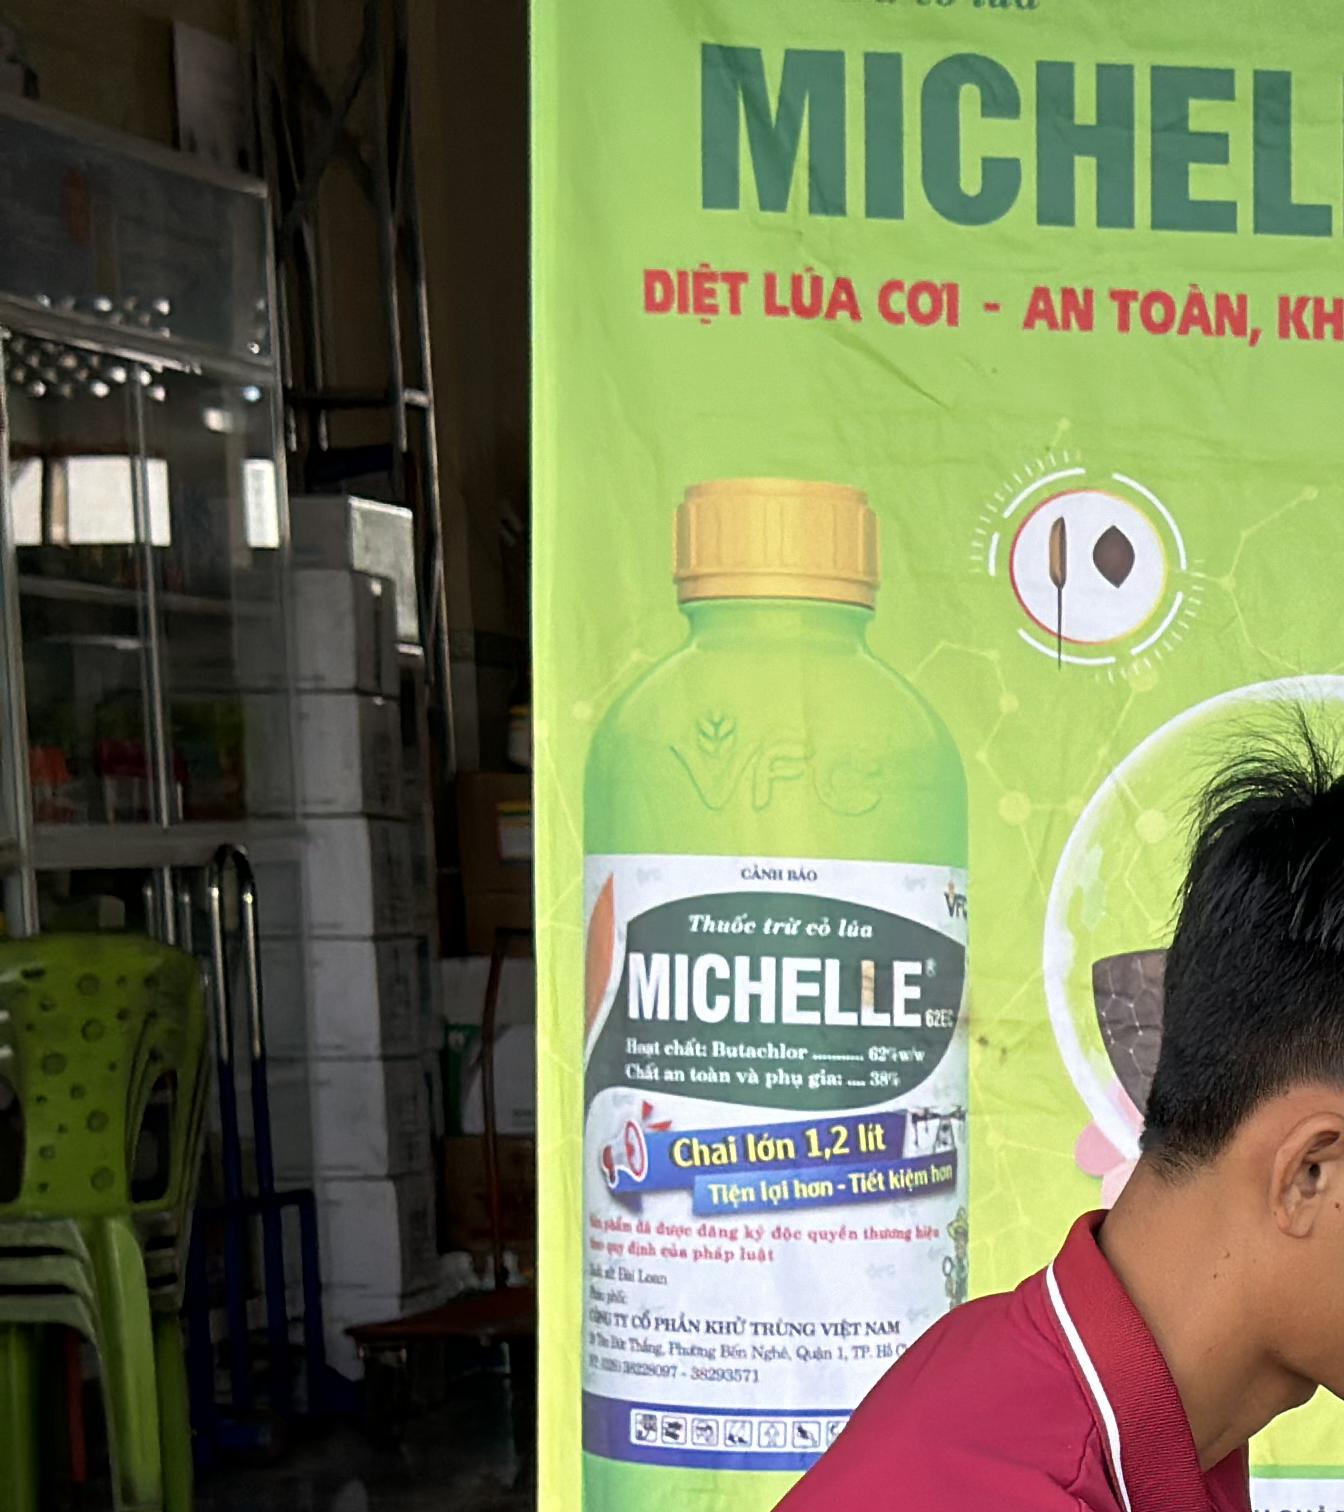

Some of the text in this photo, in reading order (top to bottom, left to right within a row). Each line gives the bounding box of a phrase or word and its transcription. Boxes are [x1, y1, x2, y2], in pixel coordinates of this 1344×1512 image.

[643, 262, 748, 324] DIỆT
[765, 266, 861, 322] LÚA
[1023, 286, 1093, 331] AN
[1109, 284, 1262, 346] TOÀN,
[688, 913, 873, 938] Thuốc trừ cỏ lúa
[625, 1037, 660, 1057] Hoạt
[664, 1036, 707, 1059] chất:
[712, 1039, 808, 1061] Butachlor
[624, 1062, 659, 1082] Chất
[663, 1069, 685, 1082] an
[690, 1065, 731, 1084] toàn
[736, 1067, 760, 1085] và
[764, 1067, 803, 1089] phụ
[808, 1069, 843, 1089] gia:
[673, 1121, 888, 1168] Chai lớn 1,2 lít
[708, 1181, 756, 1209] Tiện
[760, 1180, 789, 1205] lợi
[794, 1179, 834, 1199] hơn
[848, 1170, 885, 1194] Tiết
[888, 1167, 929, 1193] kiệm
[656, 1220, 692, 1240] được
[771, 1225, 801, 1242] độc
[740, 1246, 774, 1262] luật
[820, 1318, 862, 1339] VIỆT
[866, 1320, 900, 1337] NAM
